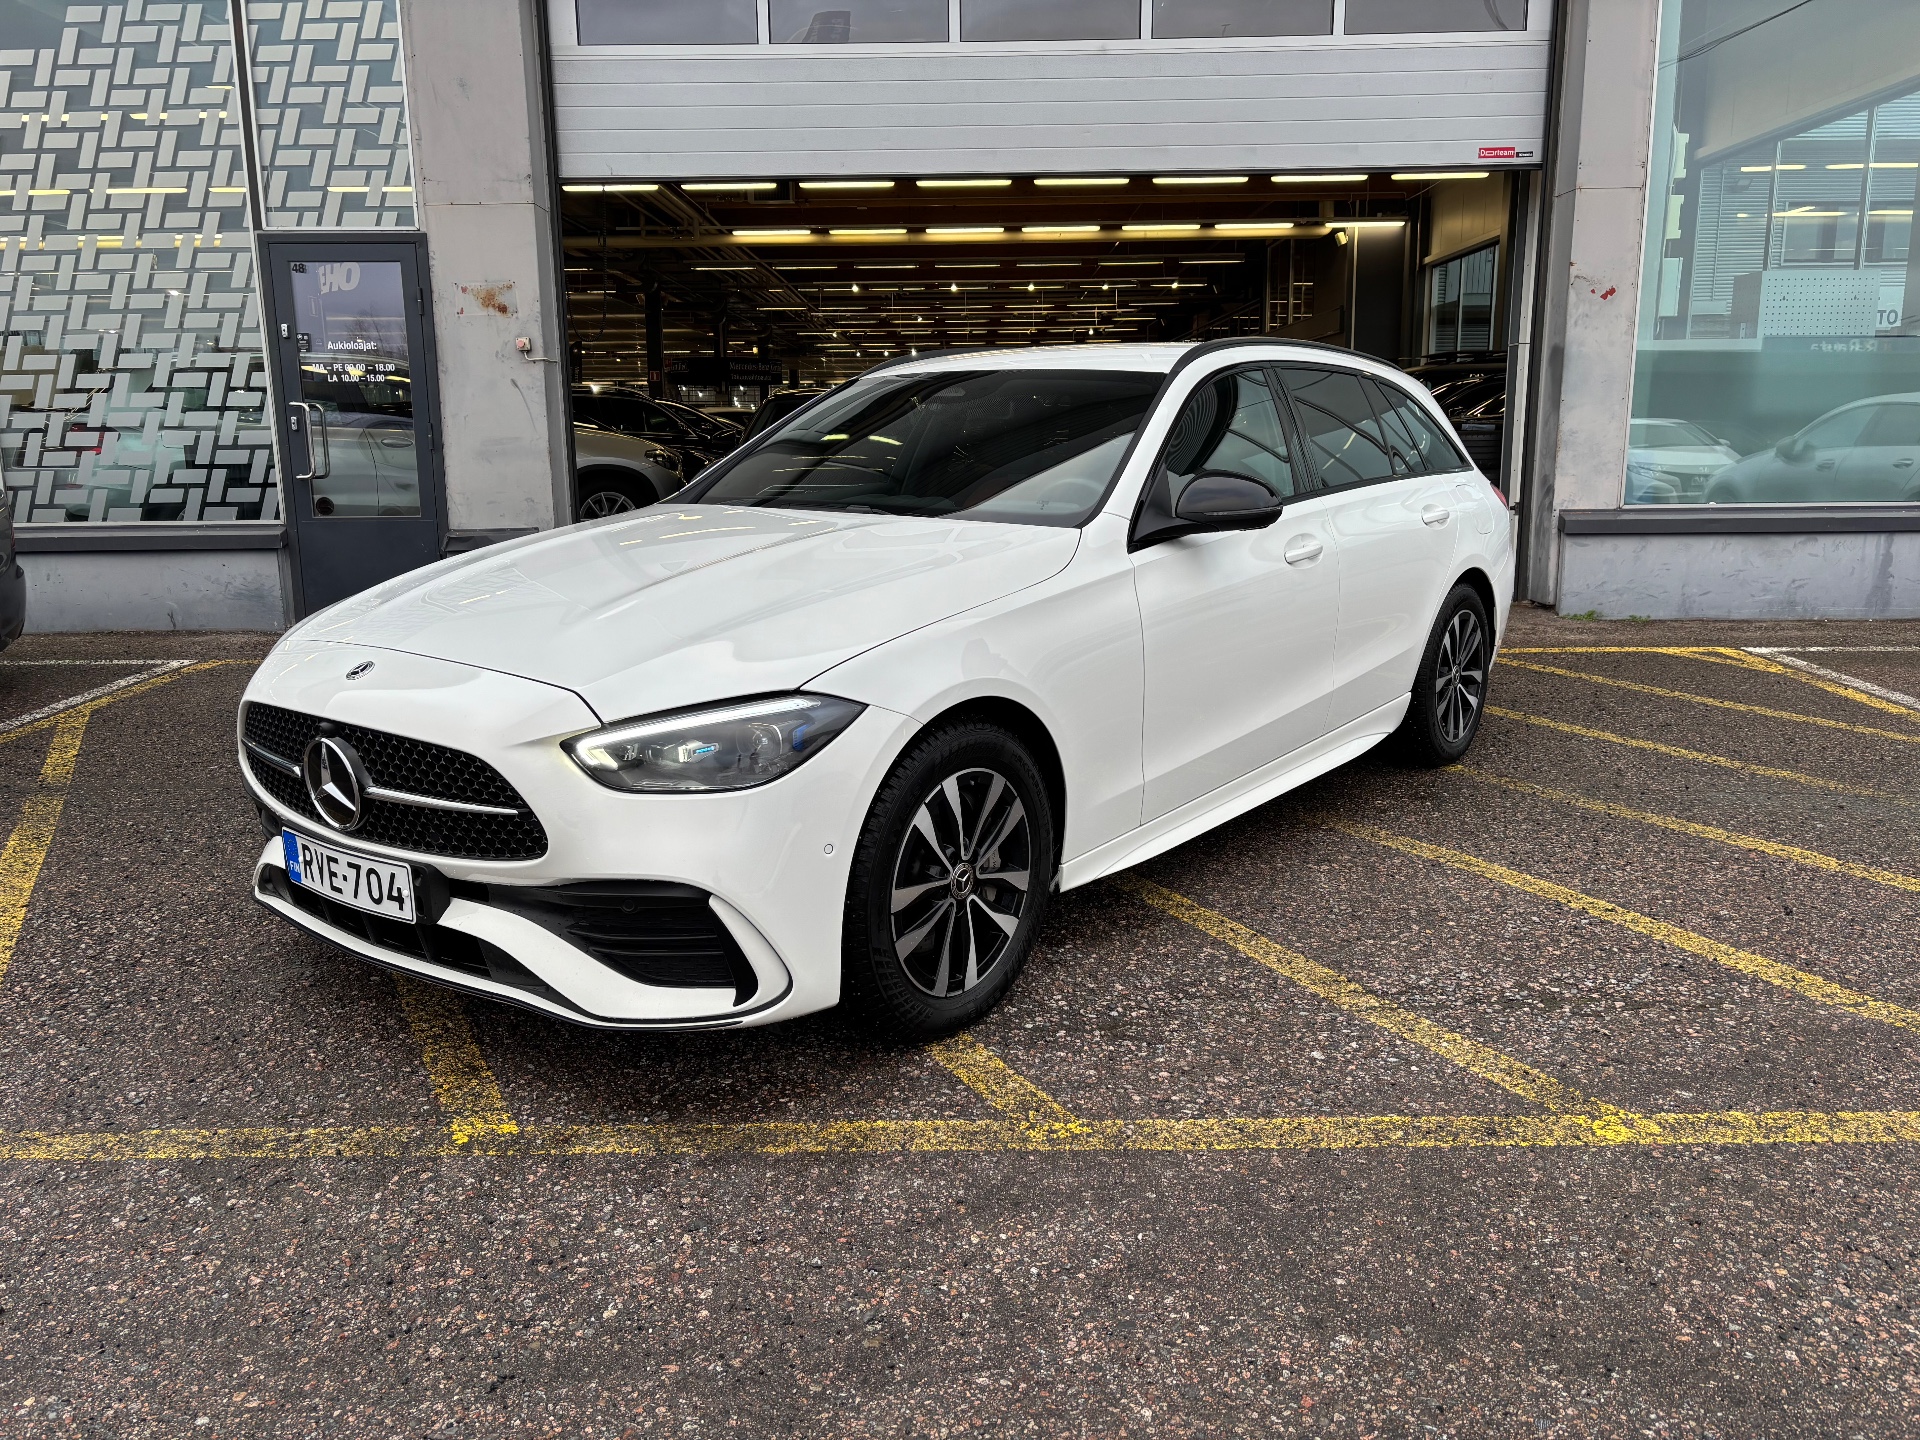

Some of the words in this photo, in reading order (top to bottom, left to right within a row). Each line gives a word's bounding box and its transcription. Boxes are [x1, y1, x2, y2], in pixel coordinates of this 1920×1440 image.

[327, 341, 377, 351] Aukioloajat:
[327, 374, 338, 382] LA
[367, 374, 385, 382] 15.00
[301, 843, 404, 911] RVE-704
